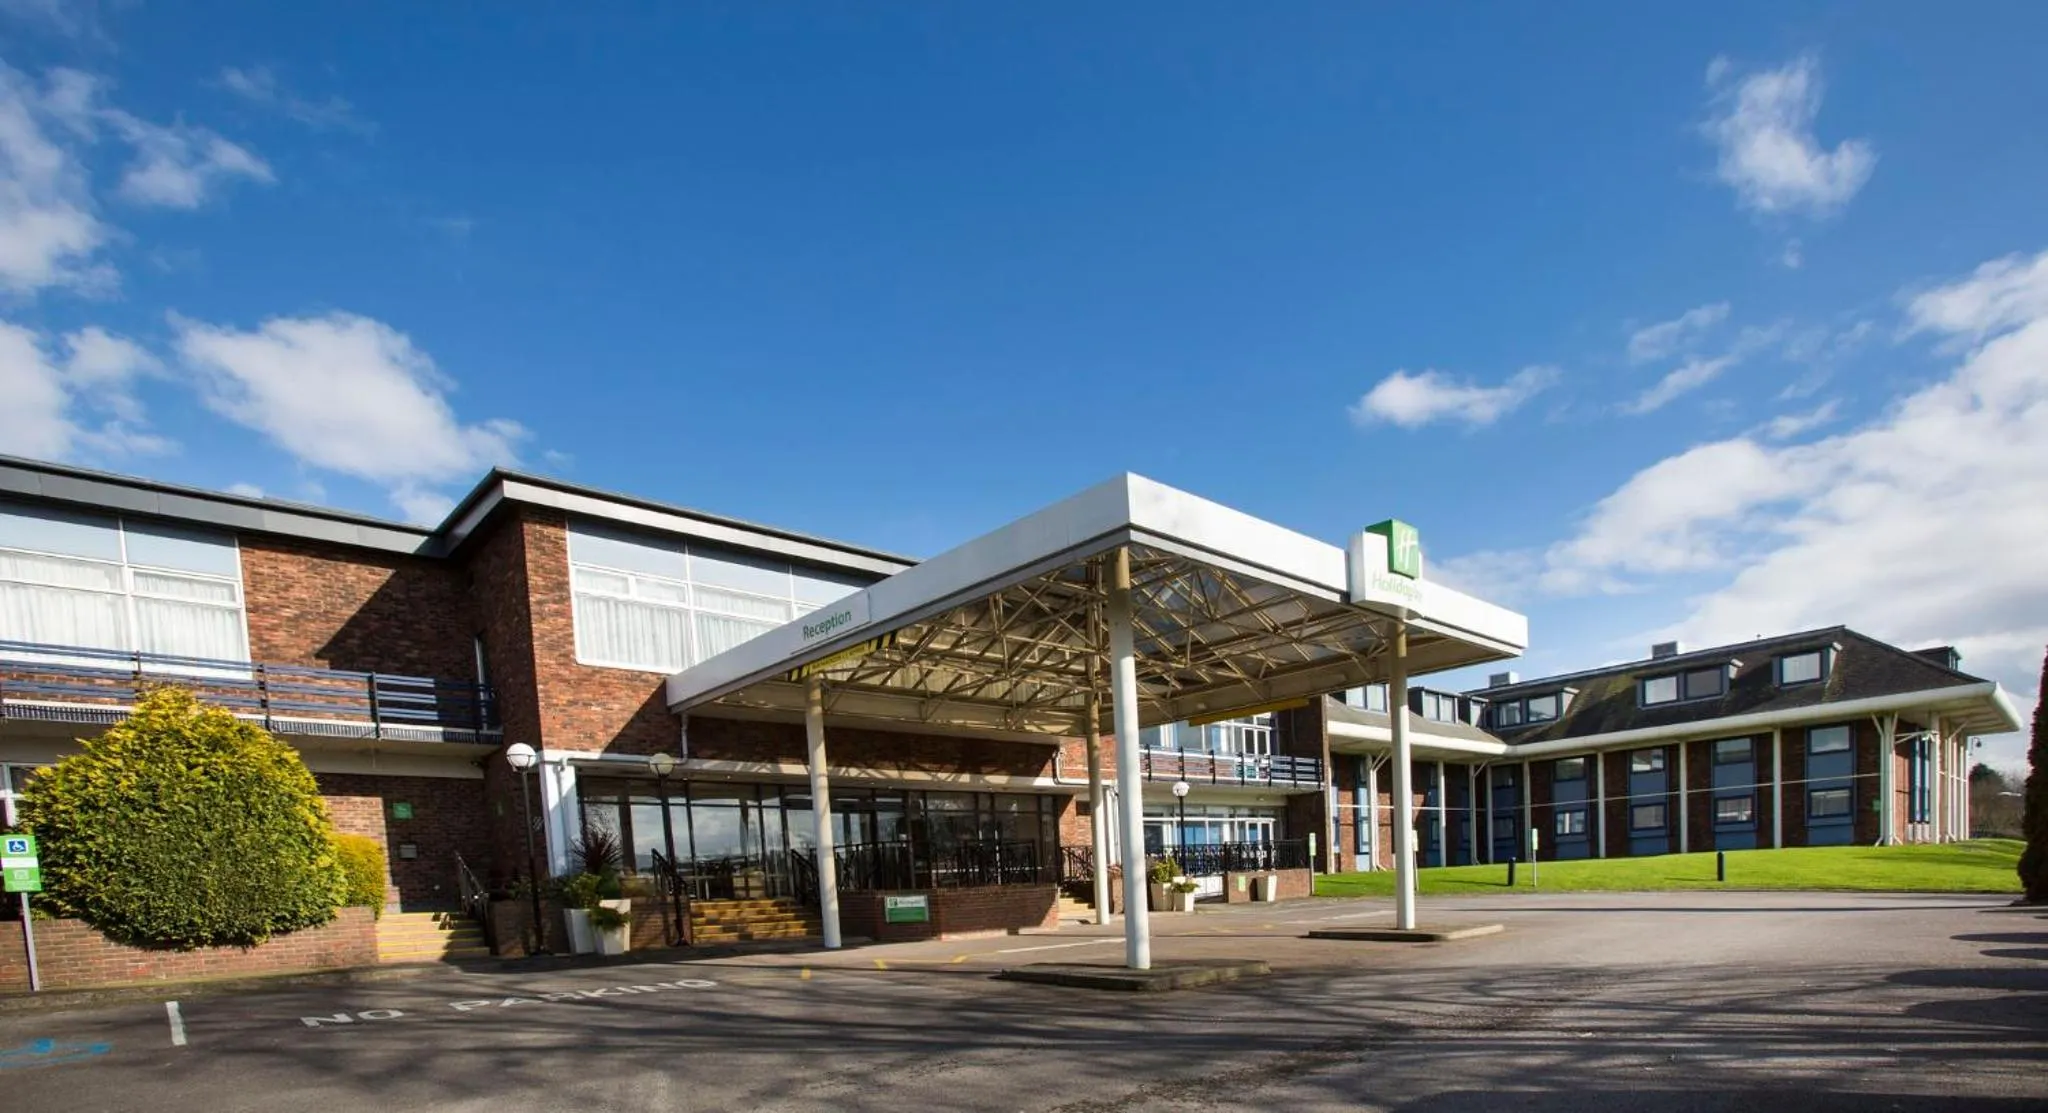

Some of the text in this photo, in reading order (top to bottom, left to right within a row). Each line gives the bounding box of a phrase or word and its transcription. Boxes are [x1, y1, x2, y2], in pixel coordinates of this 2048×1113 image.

[802, 610, 852, 640] Reception
[301, 978, 718, 1028] NO PARKING
